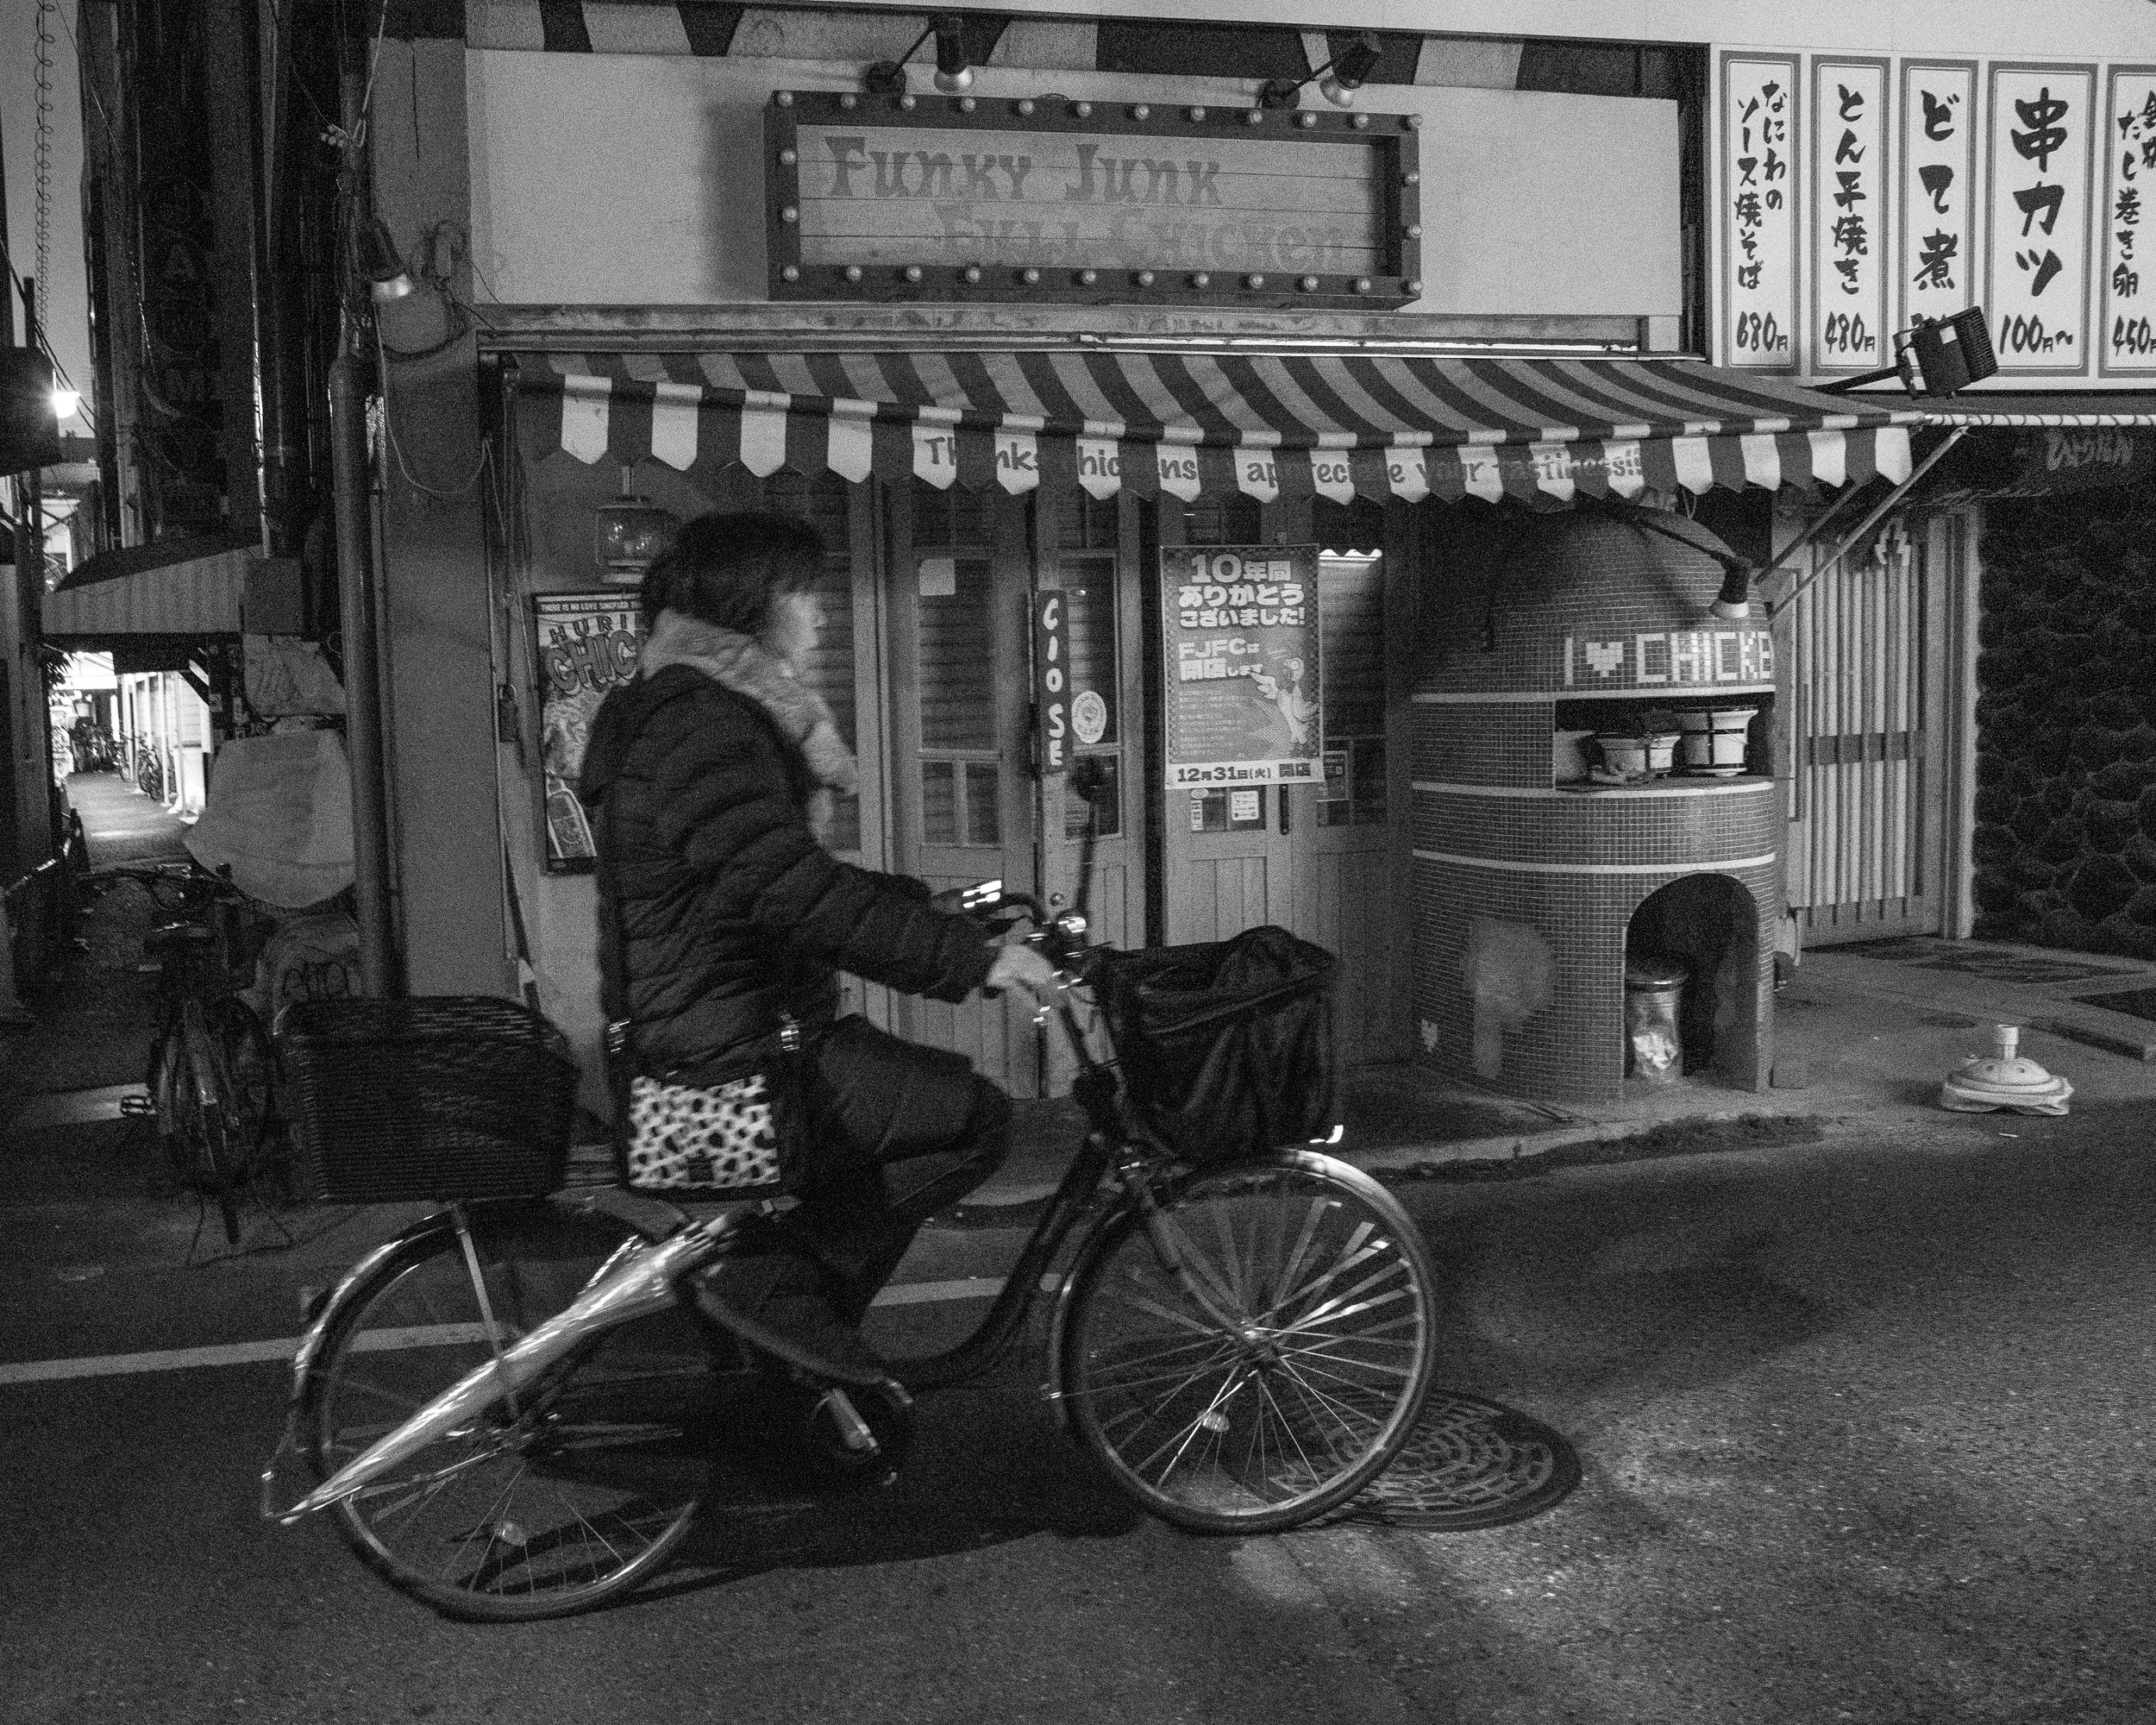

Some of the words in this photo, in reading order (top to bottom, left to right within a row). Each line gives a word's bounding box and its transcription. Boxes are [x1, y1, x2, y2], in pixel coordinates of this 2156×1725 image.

[1065, 142, 1222, 204] Junk
[1733, 96, 1762, 290] ソース焼そば
[1762, 79, 1788, 210] なにわの
[1832, 84, 1868, 295] とん平焼き
[1913, 89, 1959, 291] どて煮
[2010, 87, 2069, 297] 串カツ
[1737, 311, 1789, 353] 680円
[1824, 311, 1876, 354] 480円
[1178, 583, 1305, 608] ありがとう
